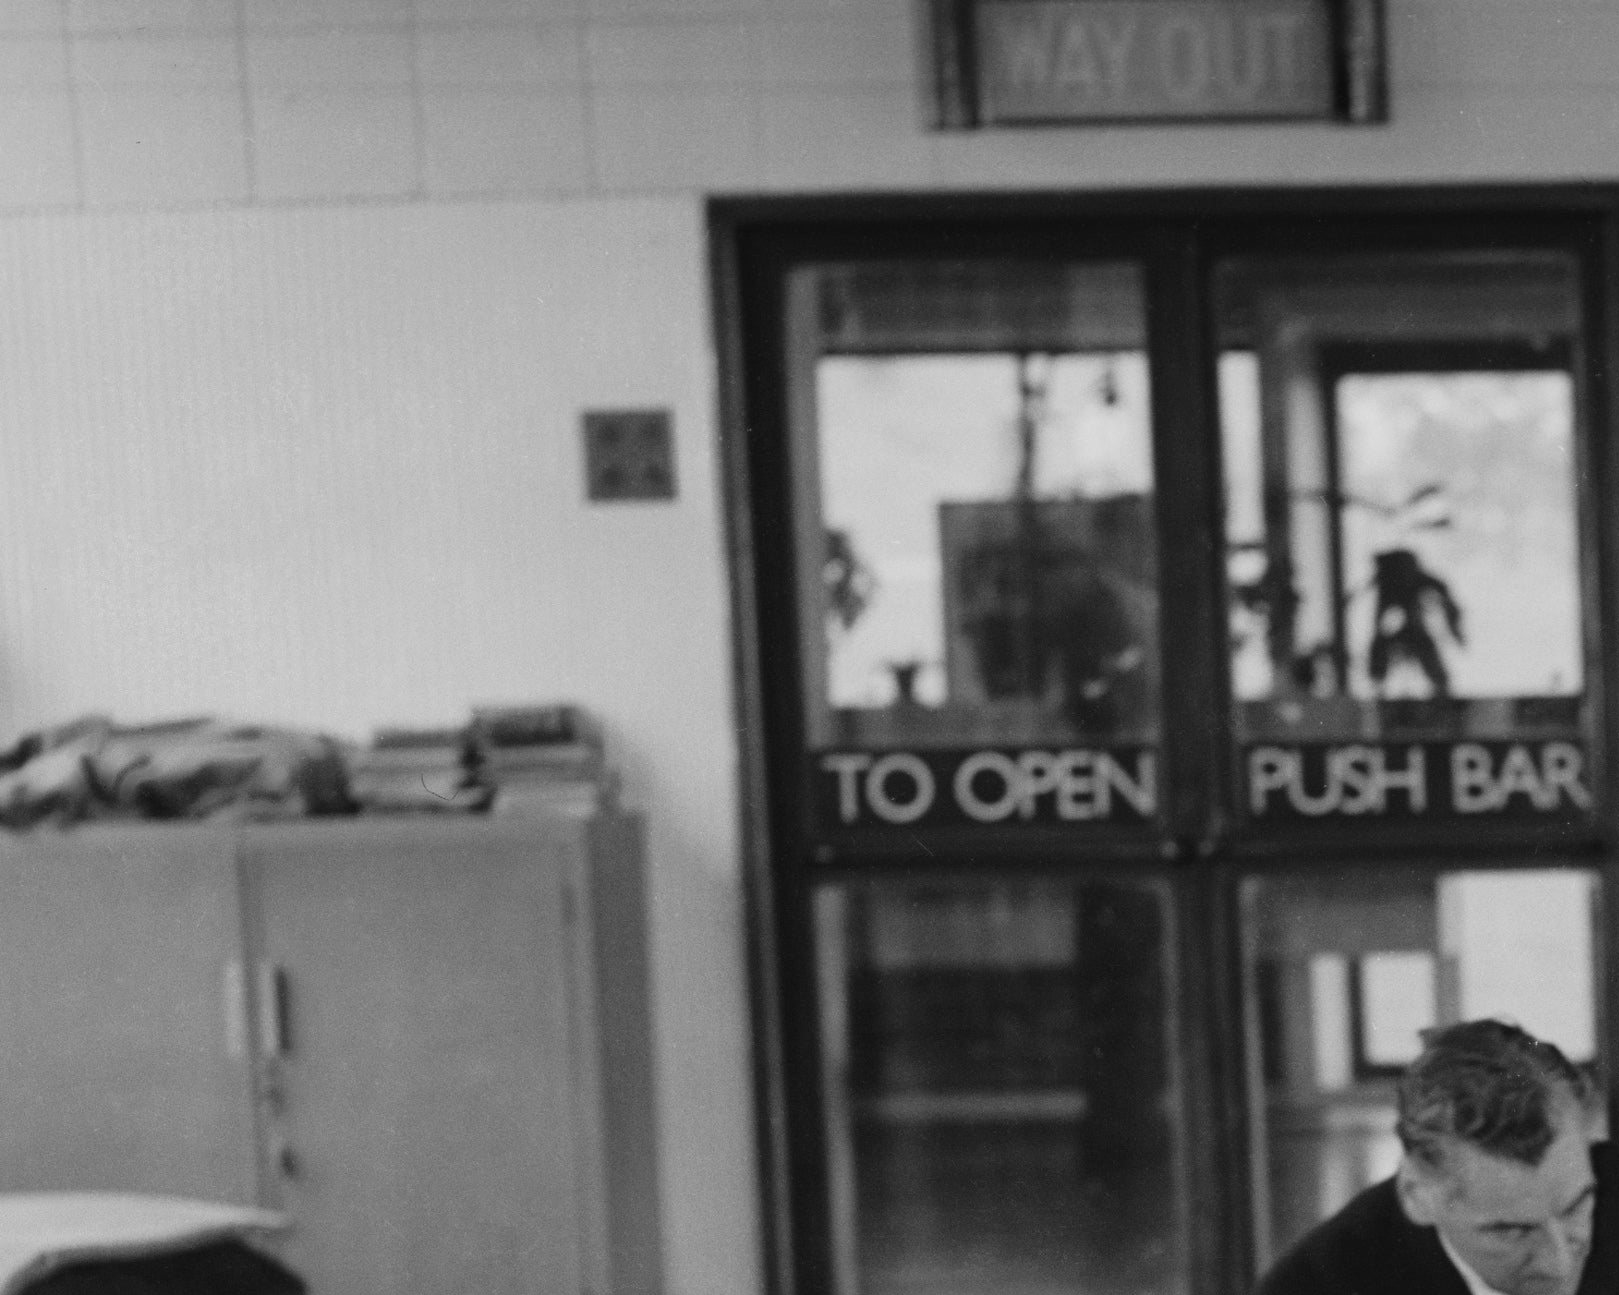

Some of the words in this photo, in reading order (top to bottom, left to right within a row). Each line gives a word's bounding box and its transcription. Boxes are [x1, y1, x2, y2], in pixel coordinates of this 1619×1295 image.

[995, 12, 1138, 98] WAY
[1159, 12, 1301, 100] OUT
[822, 754, 937, 823] TO
[953, 752, 1156, 822] OPEN
[1249, 747, 1426, 816] PUSH
[1451, 744, 1593, 812] BAR
